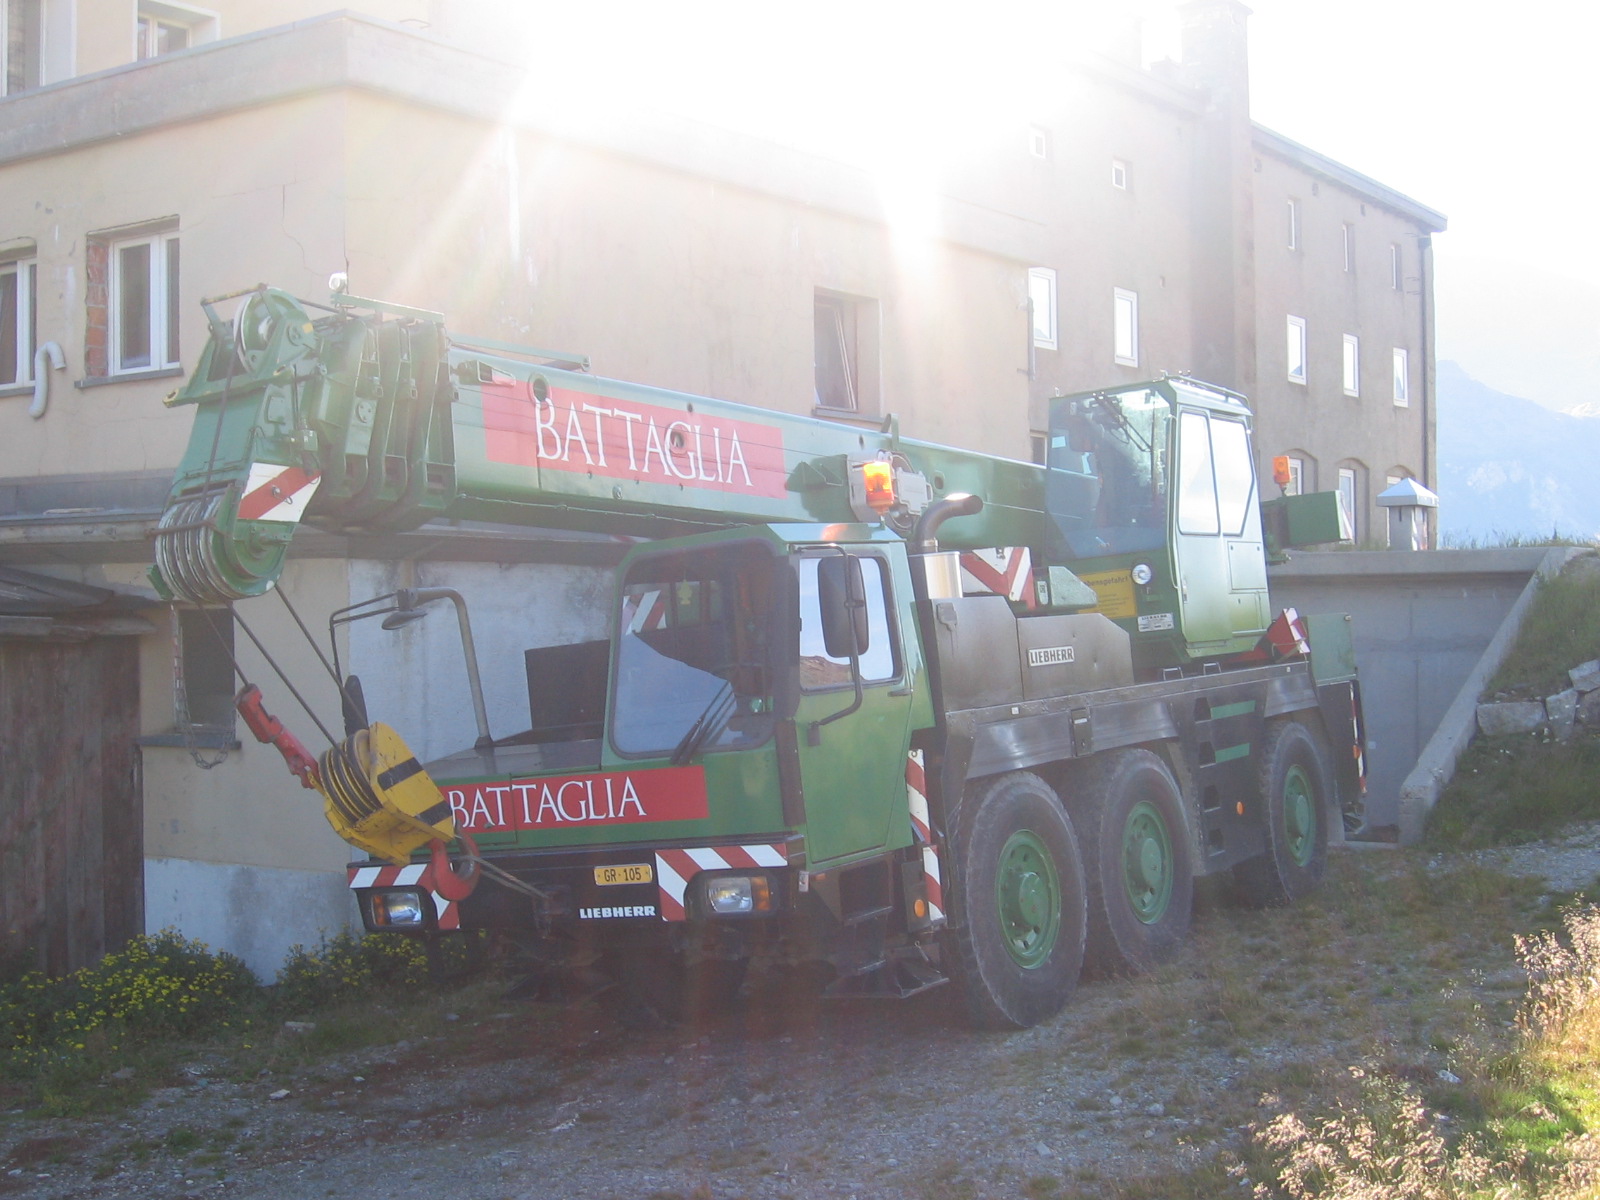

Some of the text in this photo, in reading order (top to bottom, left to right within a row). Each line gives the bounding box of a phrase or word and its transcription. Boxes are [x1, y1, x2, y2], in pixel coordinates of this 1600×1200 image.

[534, 397, 754, 487] BATTAGLIA
[1030, 648, 1074, 663] LIEBHERR
[448, 776, 647, 828] BATTAGLIA
[579, 905, 656, 919] LIEBHERR
